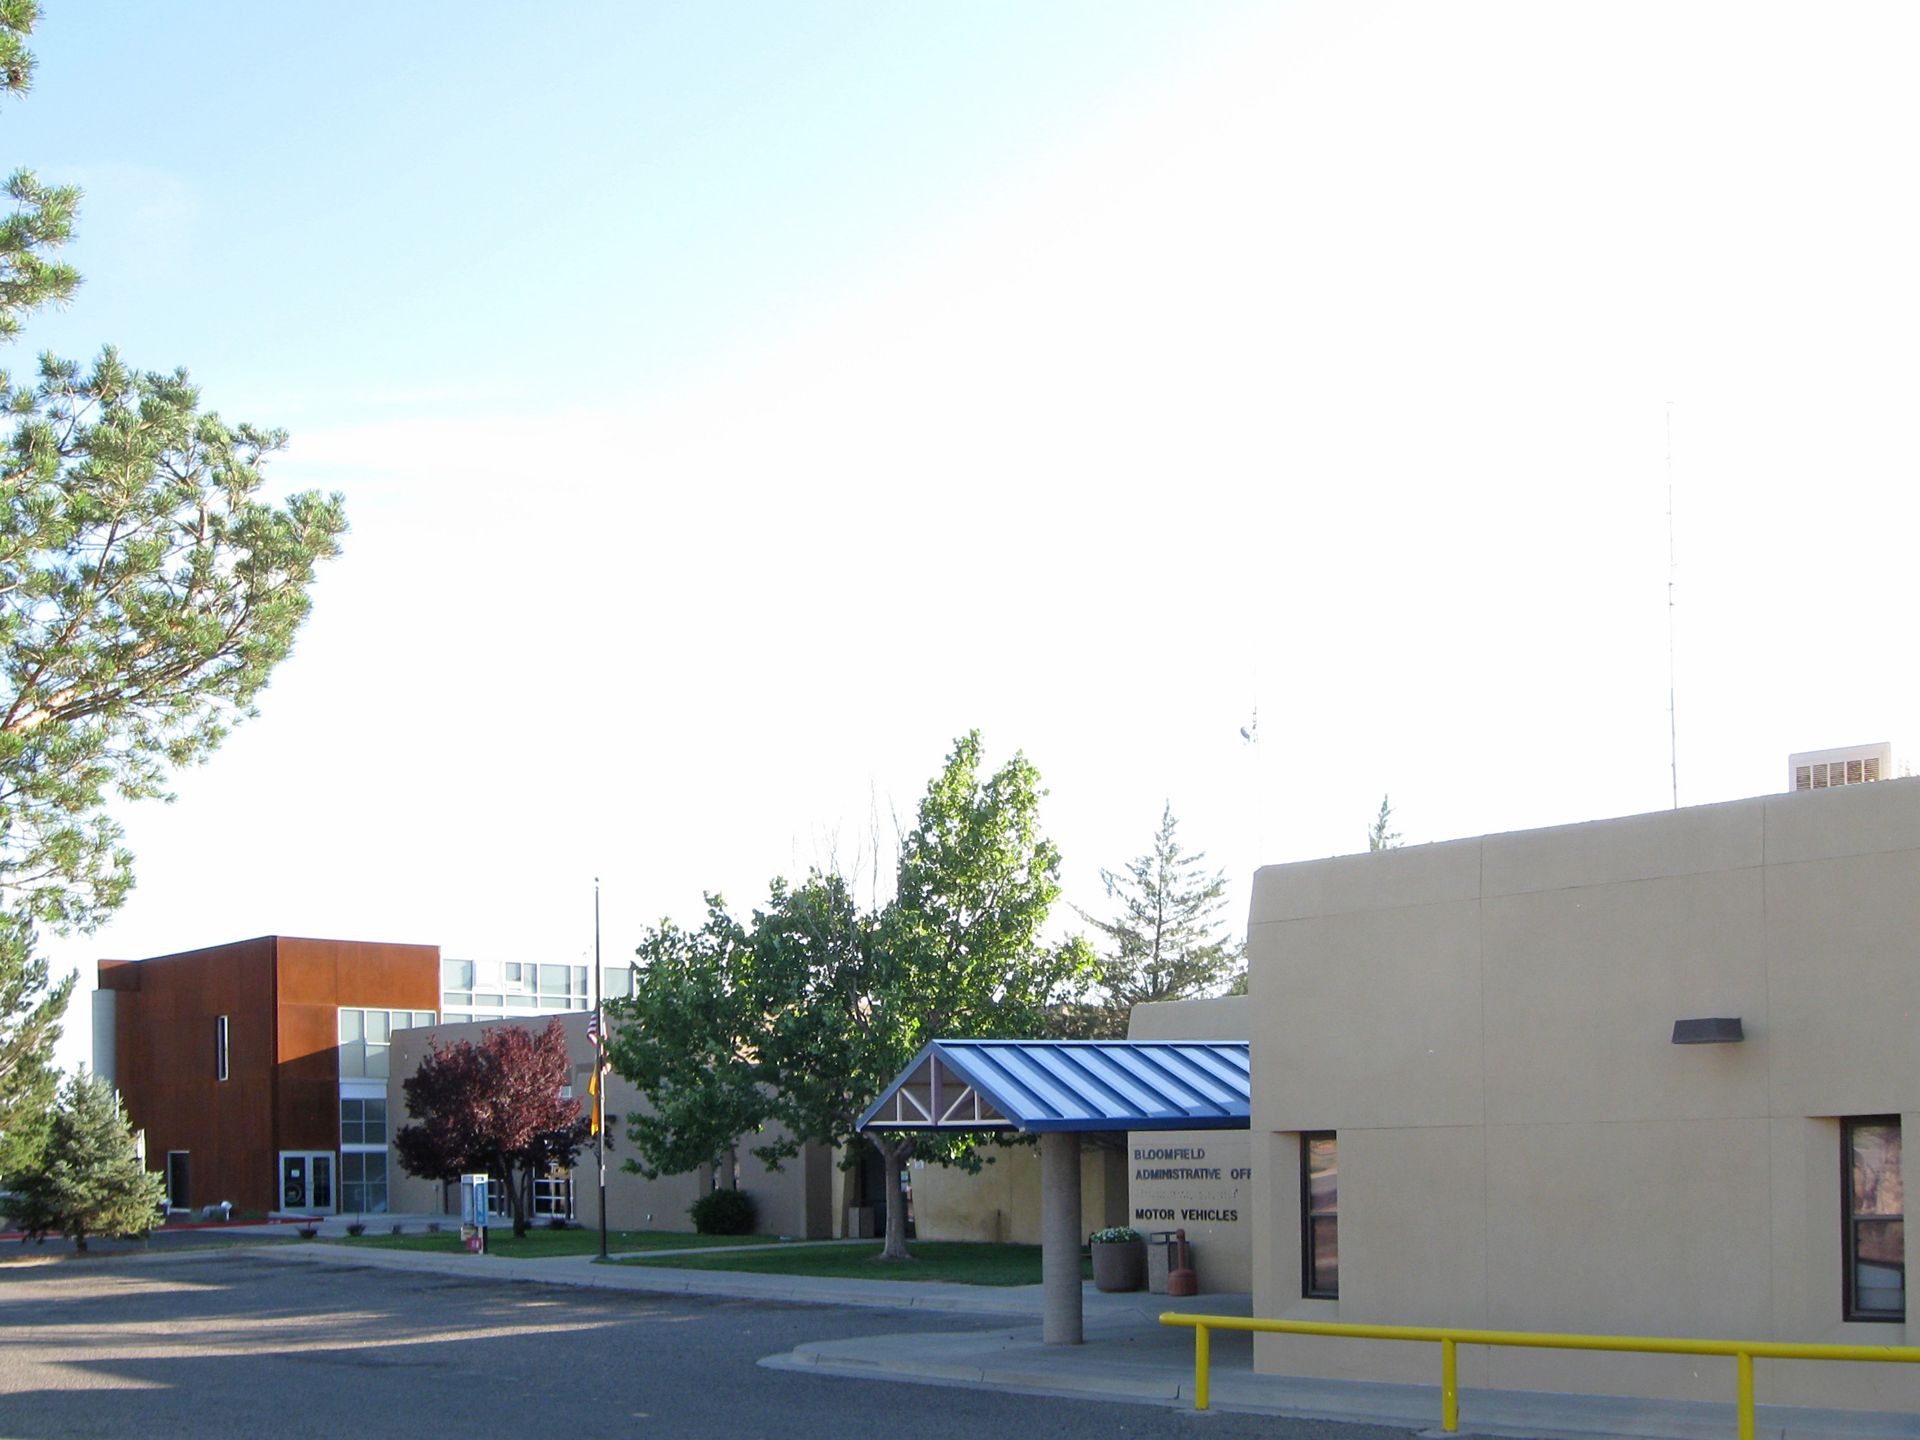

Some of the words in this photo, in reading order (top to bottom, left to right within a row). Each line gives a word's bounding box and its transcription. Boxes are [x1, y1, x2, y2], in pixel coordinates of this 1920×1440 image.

[1134, 1149, 1205, 1160] BLOOMFIELD
[1136, 1168, 1221, 1180] ADMINISTRATIVE
[1136, 1209, 1175, 1220] MOTOR
[1181, 1210, 1238, 1221] VEHICLES
